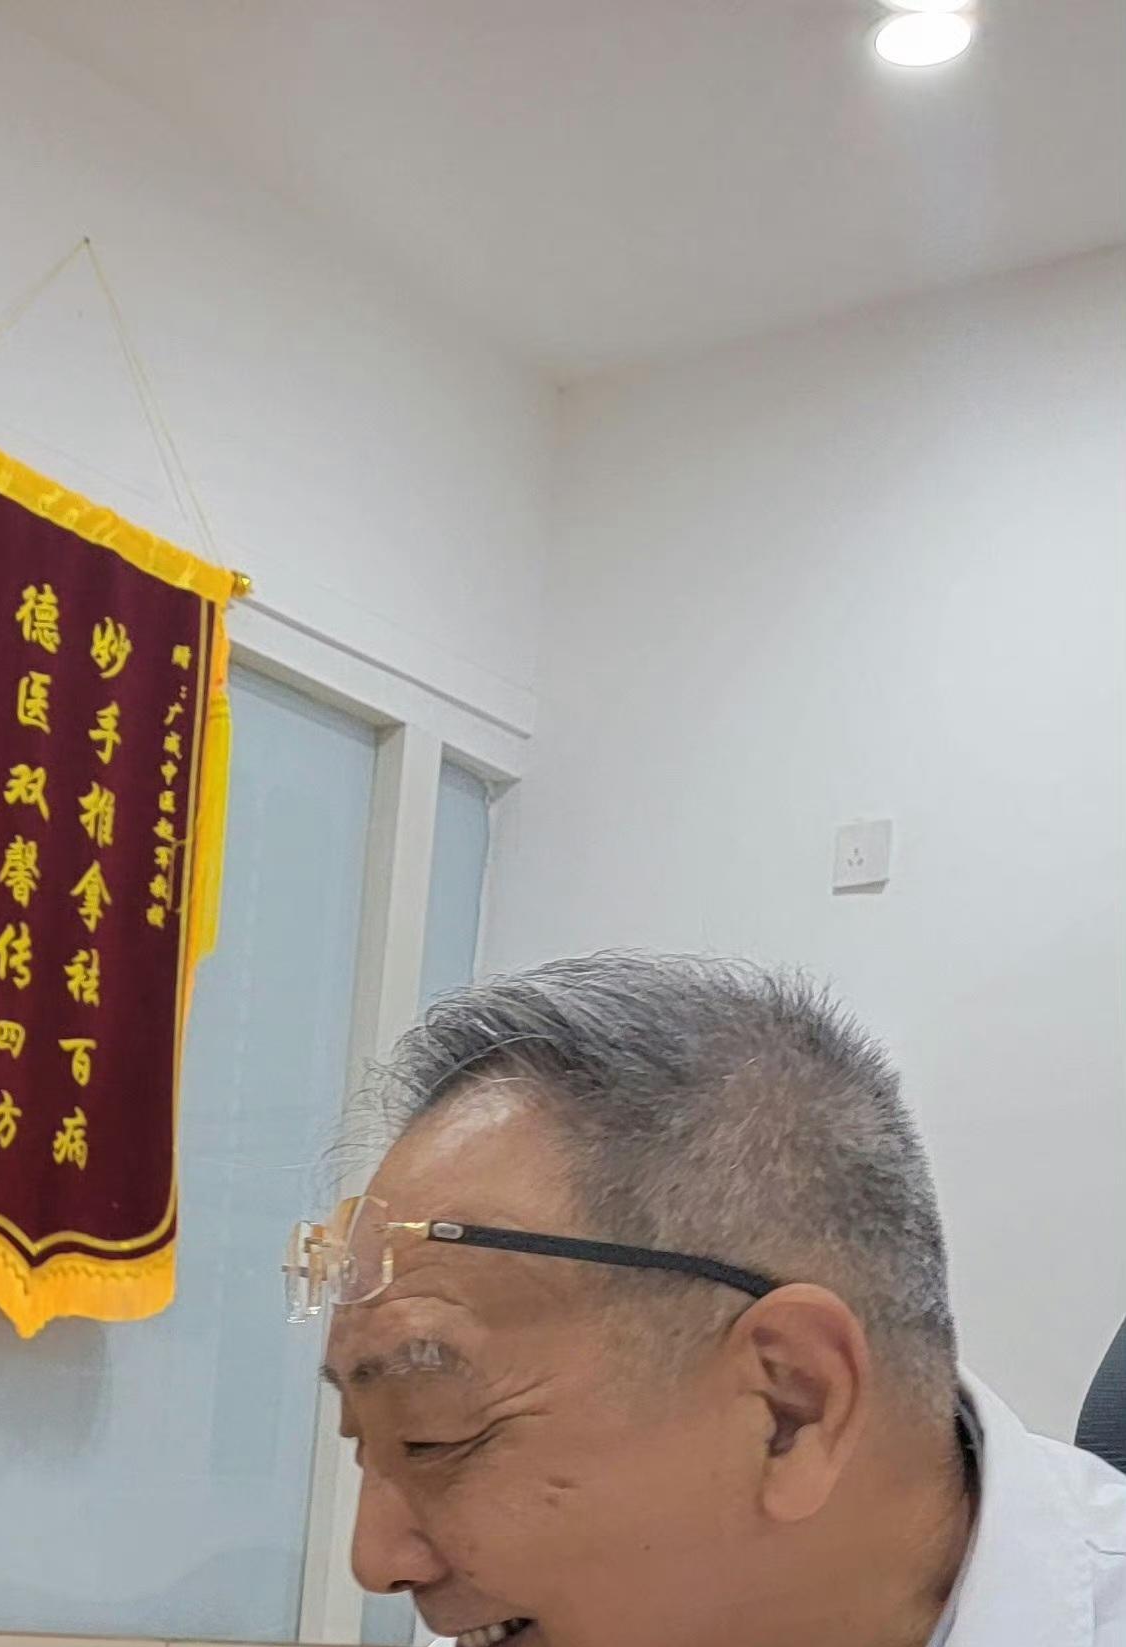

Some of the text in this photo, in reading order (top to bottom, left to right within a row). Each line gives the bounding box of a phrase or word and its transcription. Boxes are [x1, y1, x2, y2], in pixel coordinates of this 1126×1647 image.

[52, 615, 134, 1171] 妙手推拿祛百病
